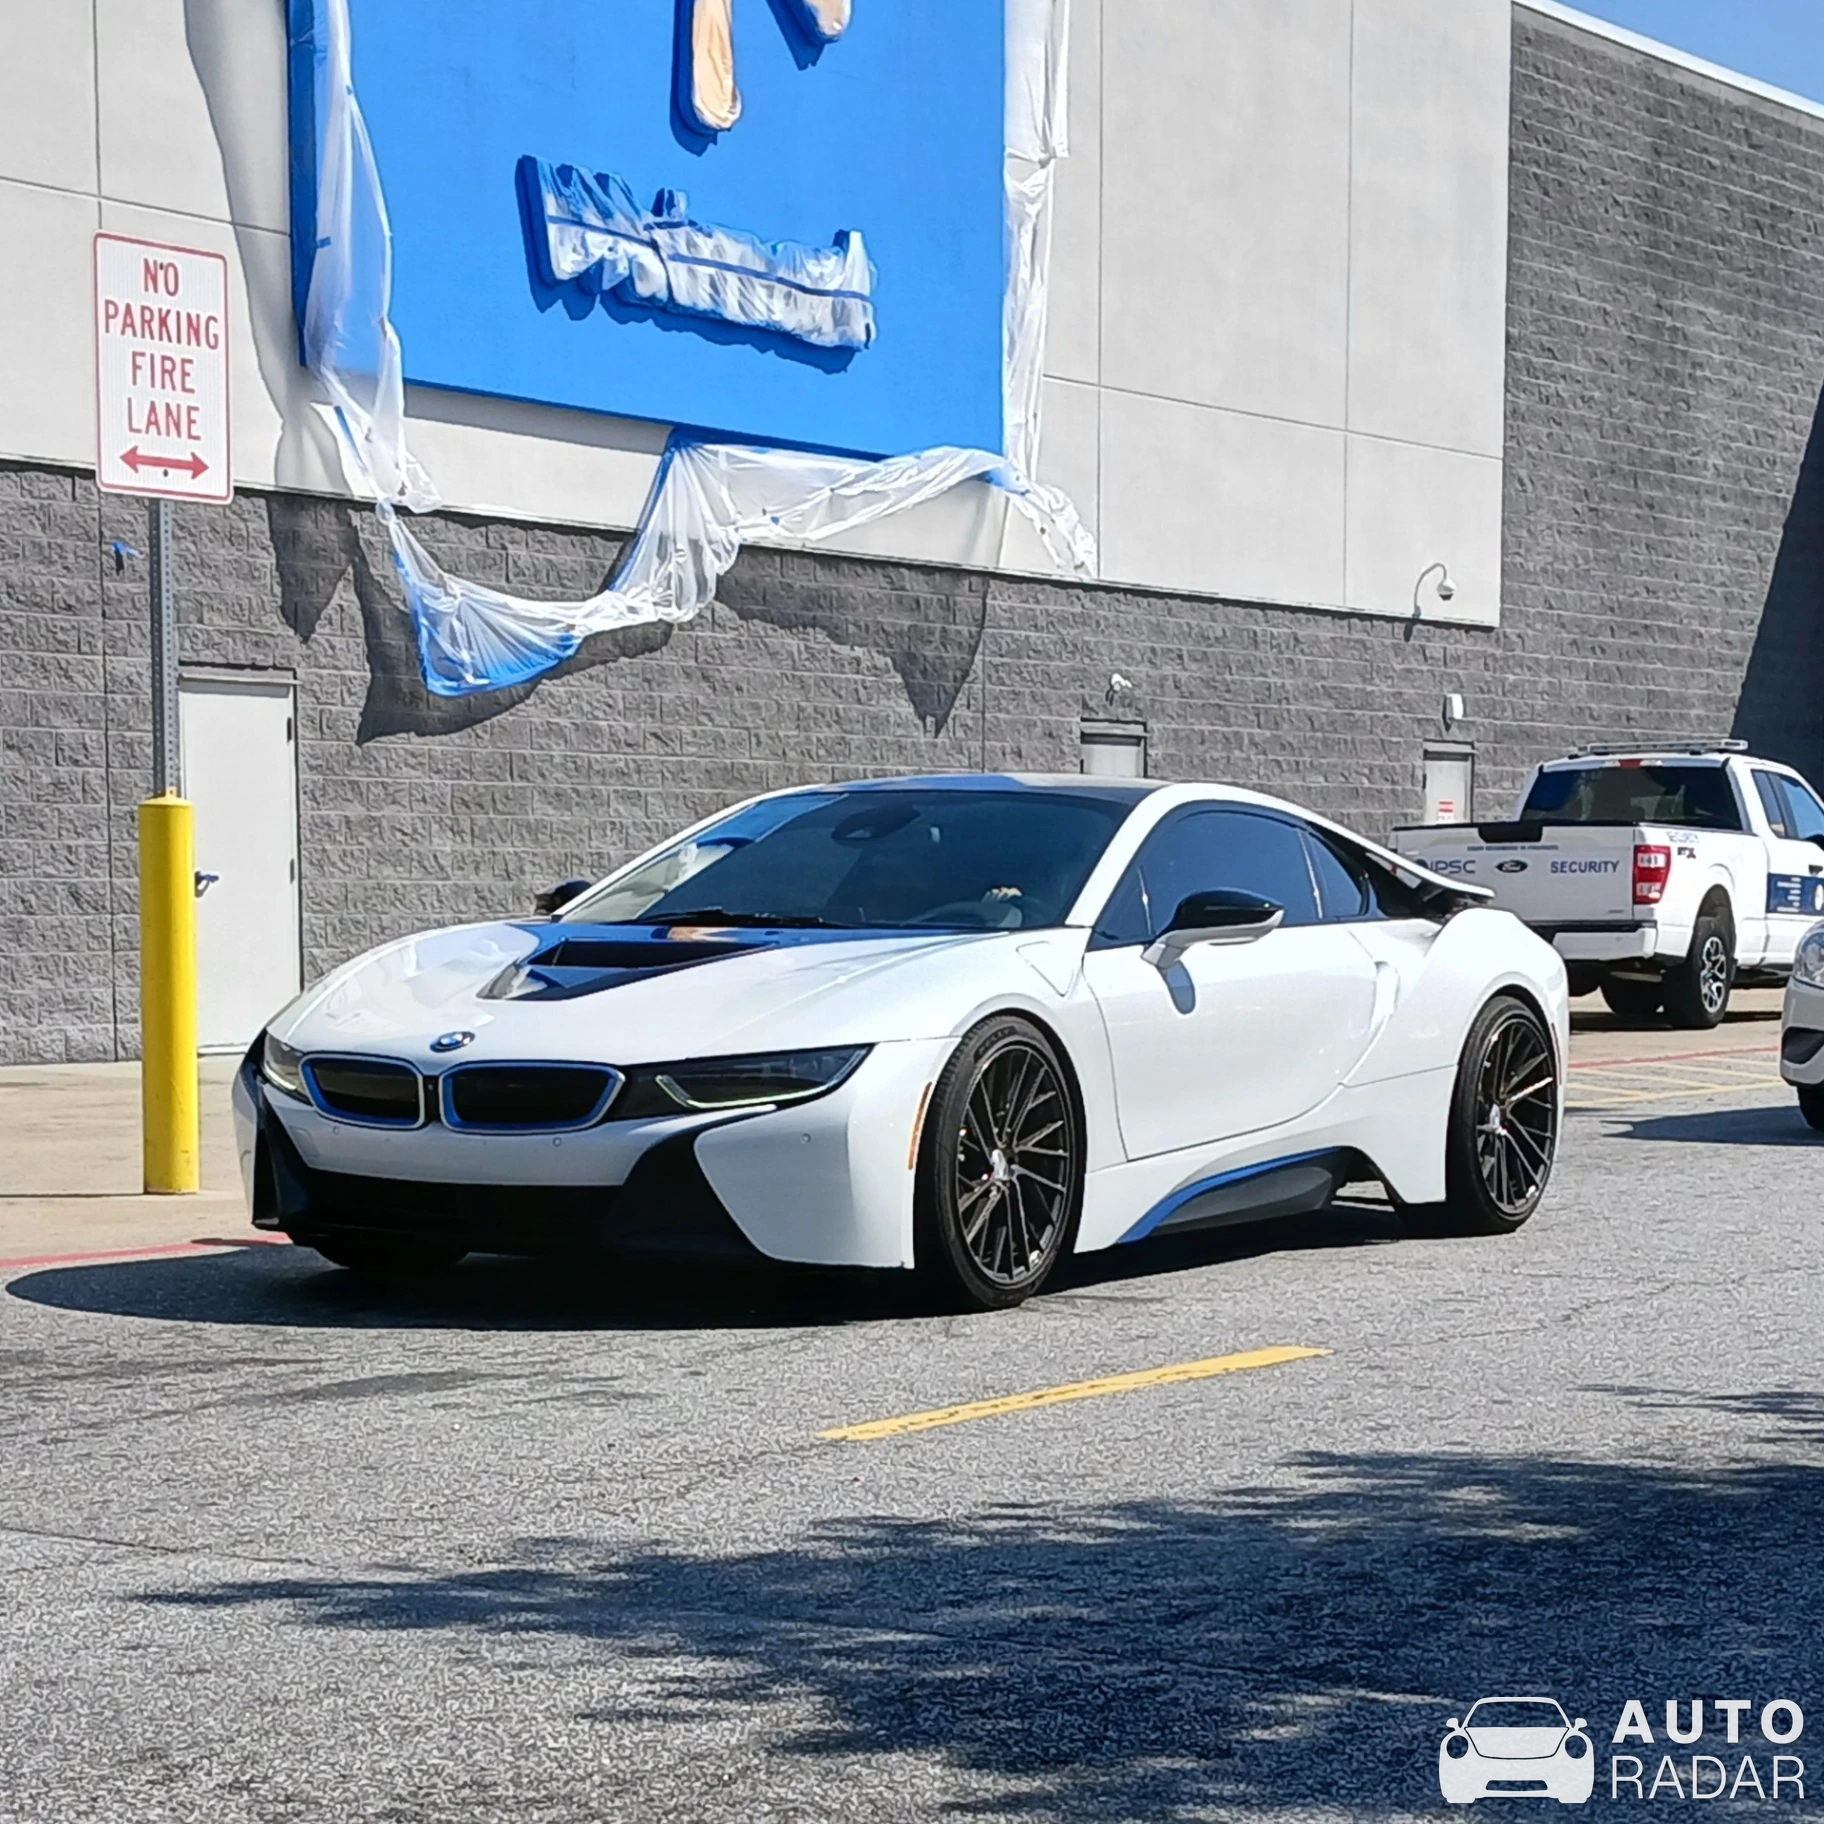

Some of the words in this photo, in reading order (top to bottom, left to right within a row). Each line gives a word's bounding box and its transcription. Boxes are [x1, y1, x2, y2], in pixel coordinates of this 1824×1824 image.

[143, 257, 180, 297] NO
[104, 299, 219, 350] PARKING
[131, 350, 196, 394] FIRE
[127, 397, 201, 441] LANE
[1550, 860, 1620, 874] SECURITY
